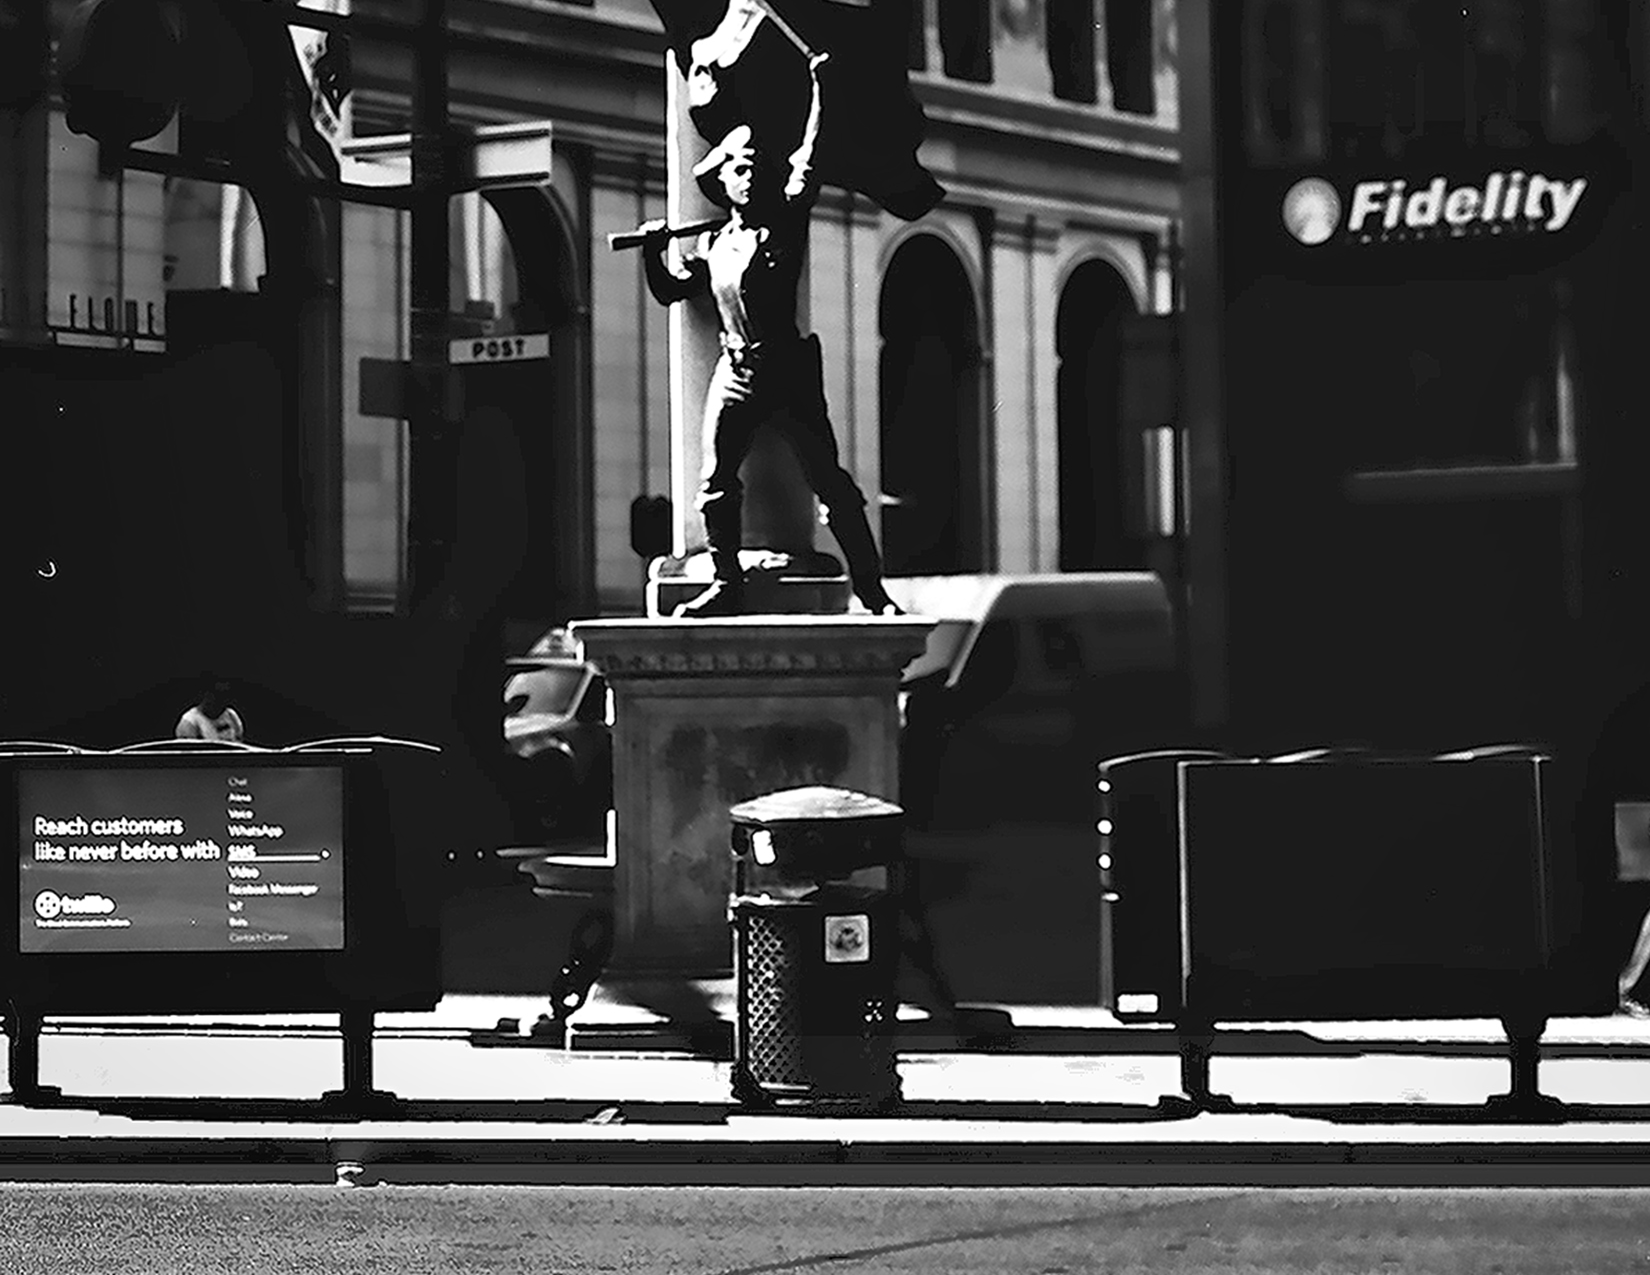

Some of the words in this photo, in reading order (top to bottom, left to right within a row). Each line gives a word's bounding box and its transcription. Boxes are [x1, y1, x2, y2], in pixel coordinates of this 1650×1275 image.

[1348, 172, 1588, 232] Fidelity
[472, 338, 525, 357] POST
[35, 816, 88, 836] Reach
[91, 817, 185, 836] customers
[35, 841, 67, 861] like
[69, 844, 119, 861] never
[120, 840, 179, 861] before
[180, 840, 221, 860] with
